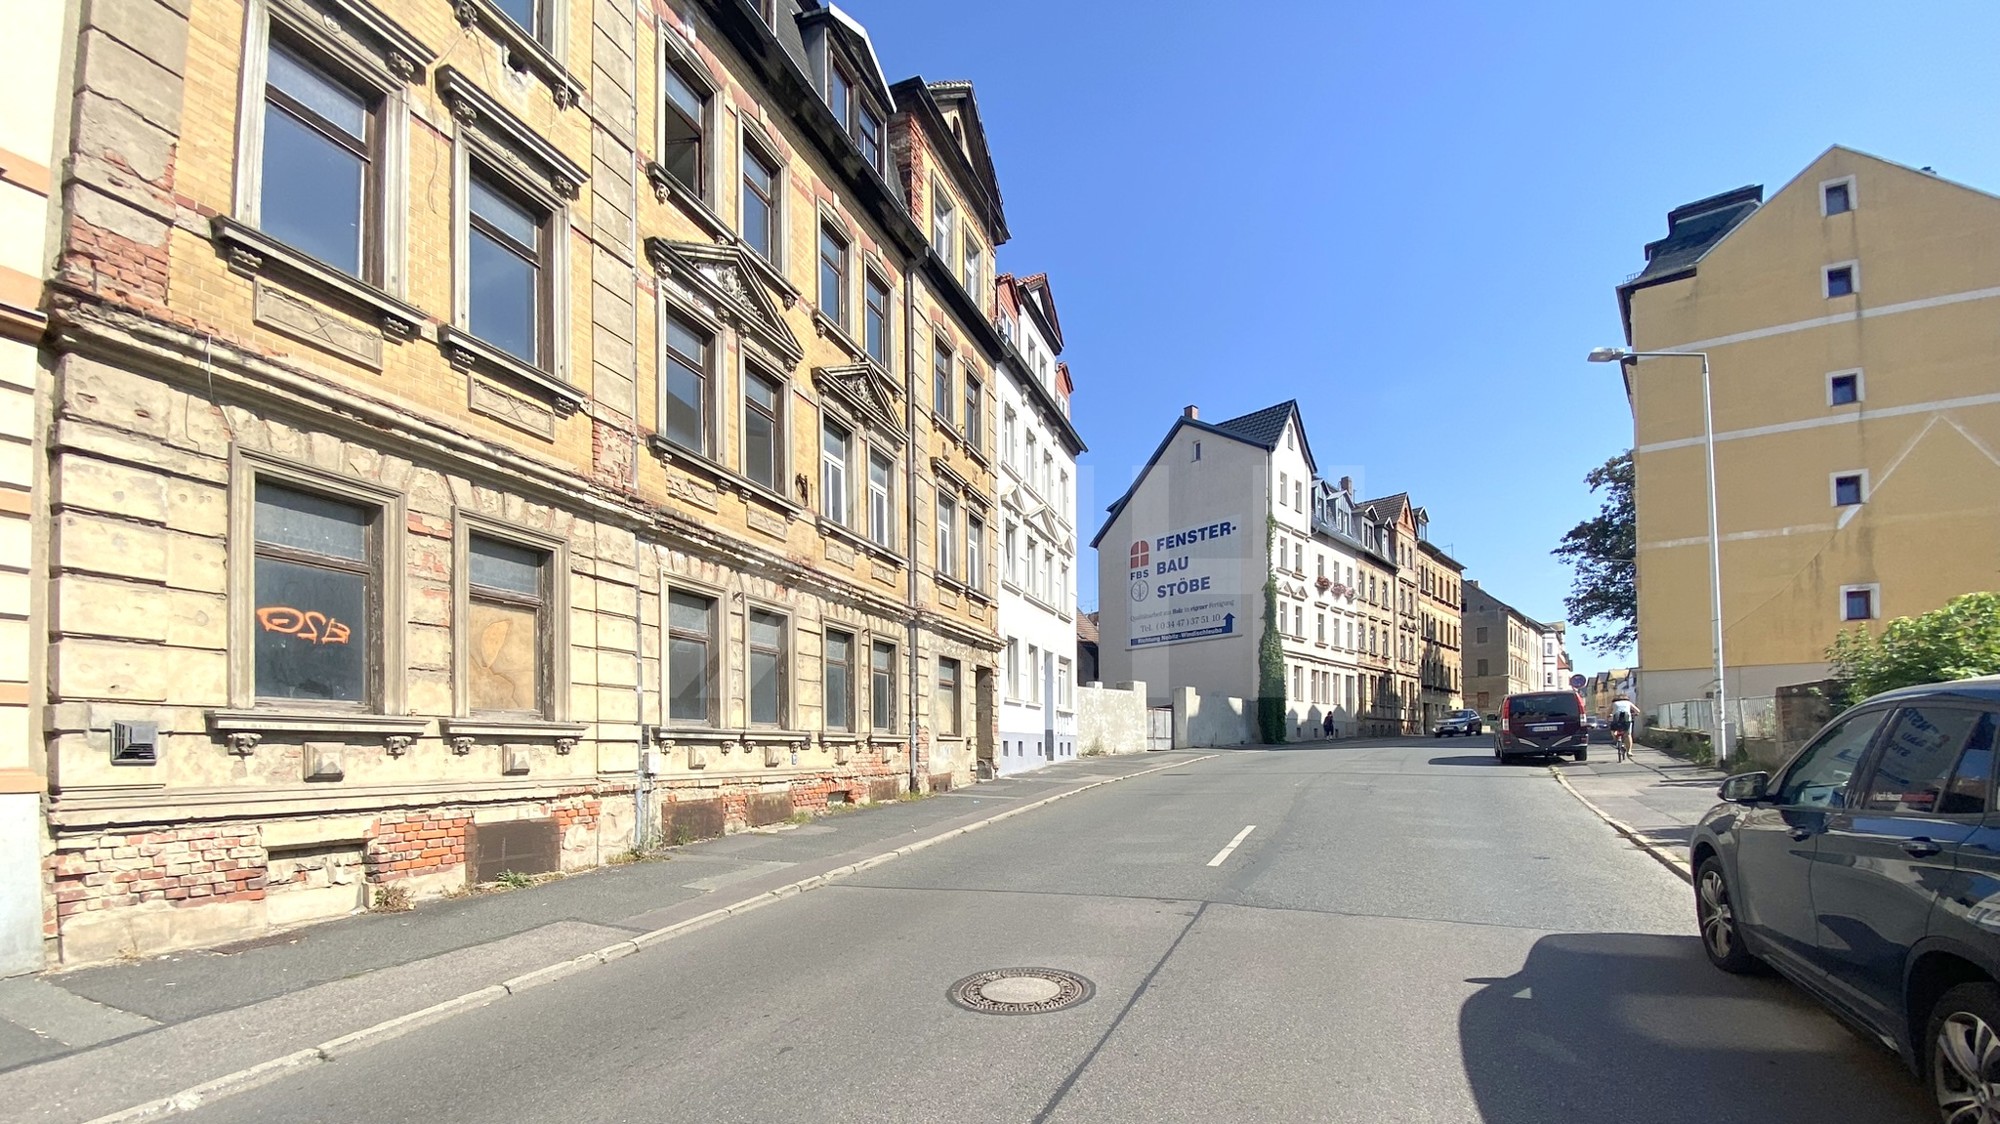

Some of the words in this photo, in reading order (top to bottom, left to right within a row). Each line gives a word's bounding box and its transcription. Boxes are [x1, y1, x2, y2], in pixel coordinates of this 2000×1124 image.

[1156, 521, 1236, 551] FENSTER-
[1130, 569, 1149, 580] FBS
[1156, 556, 1188, 575] BAU
[1157, 576, 1210, 598] STÖBE
